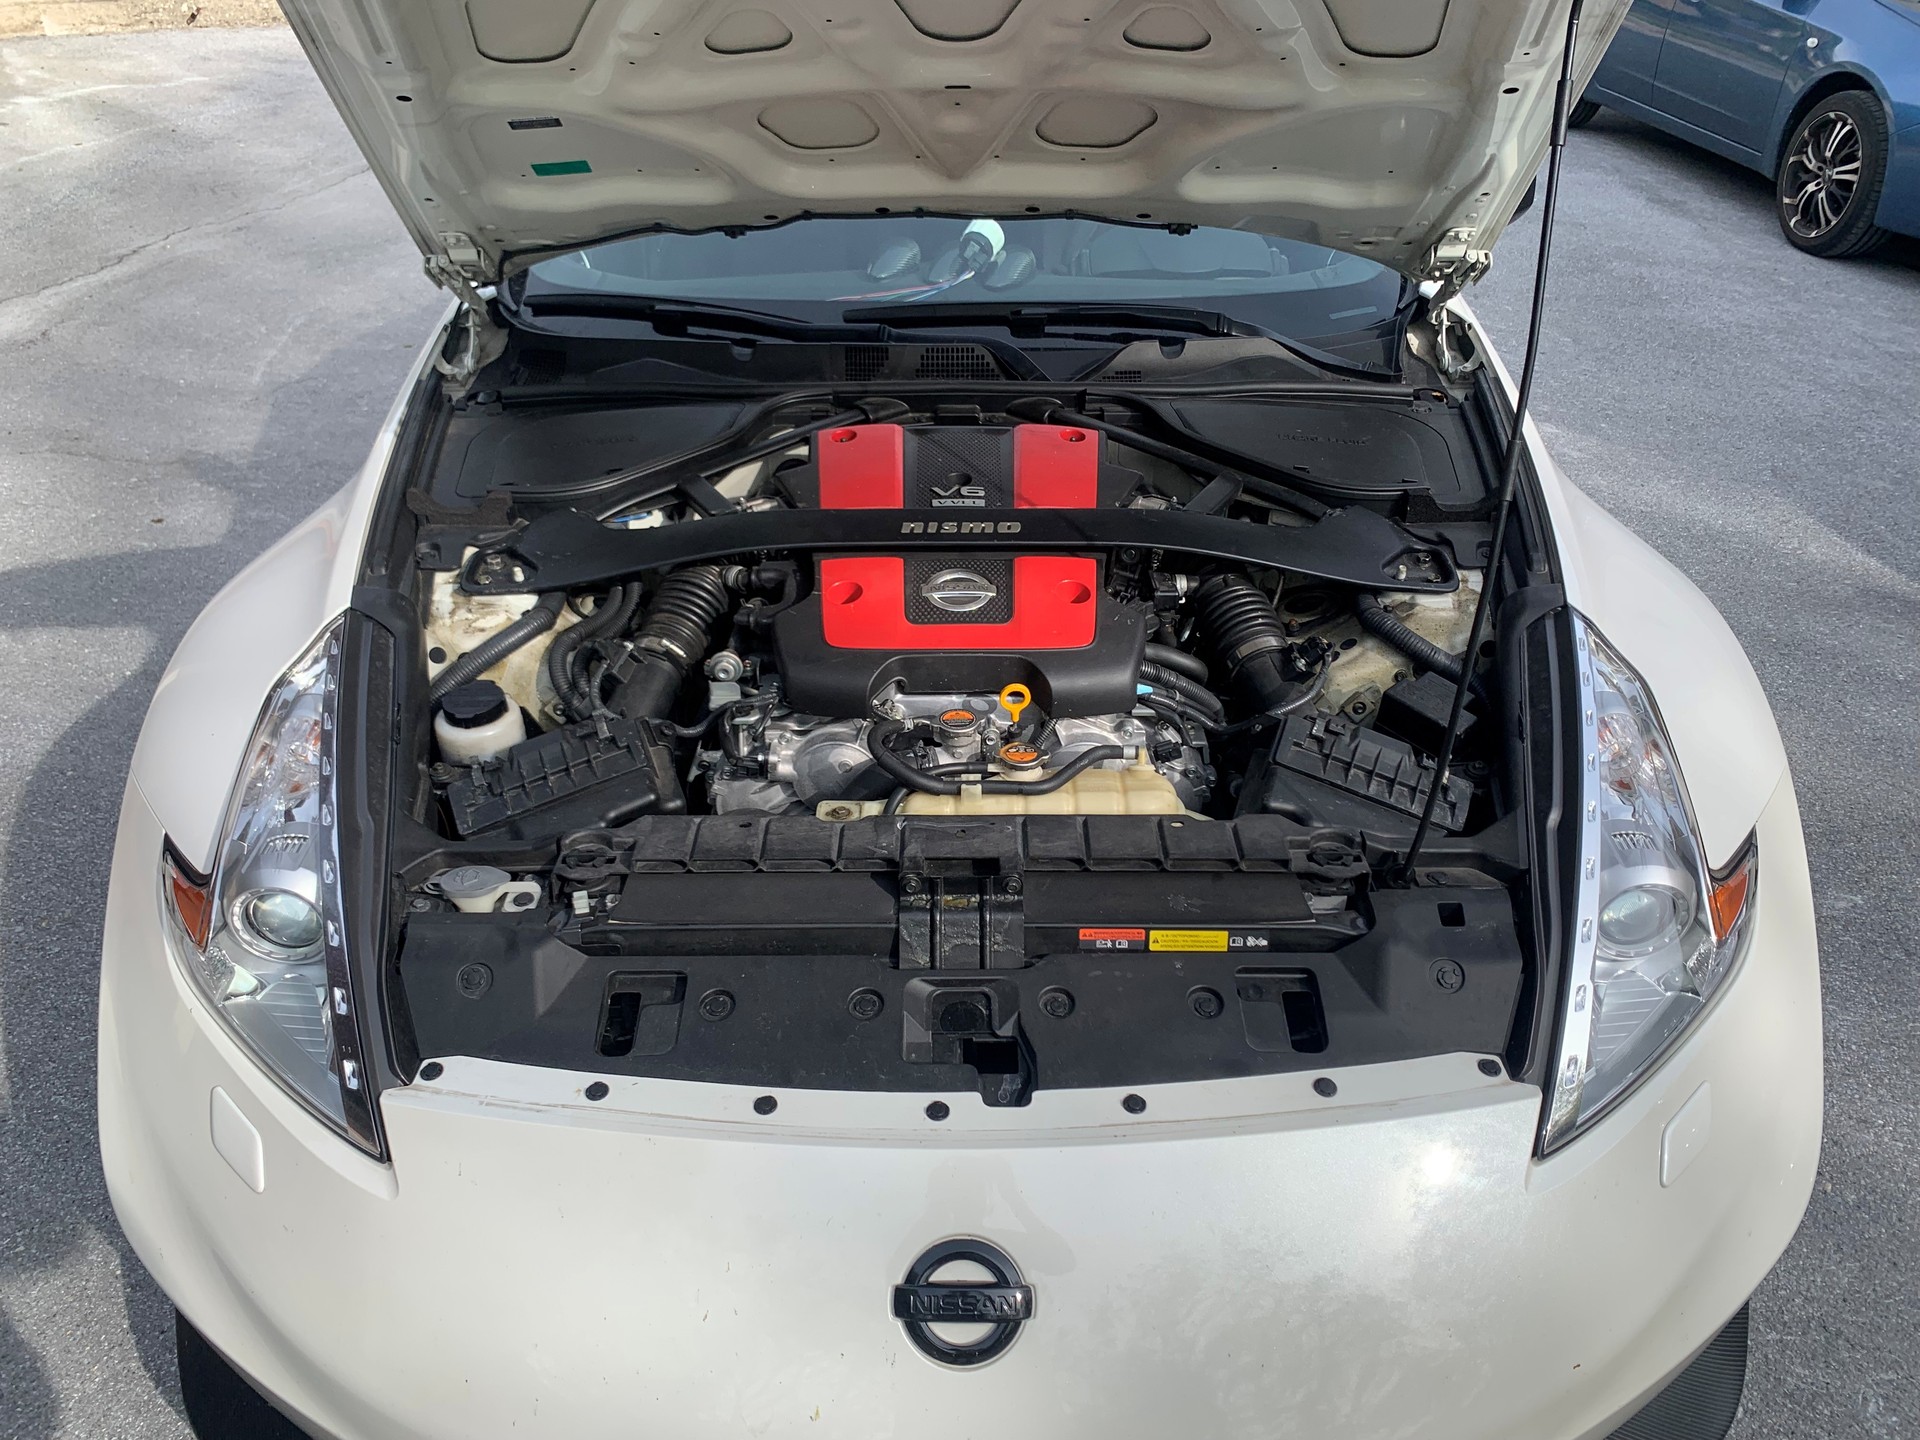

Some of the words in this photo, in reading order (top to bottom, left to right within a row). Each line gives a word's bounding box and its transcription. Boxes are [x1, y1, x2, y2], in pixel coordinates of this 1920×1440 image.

[931, 484, 986, 497] V6
[929, 583, 989, 592] NISSAN
[910, 1294, 1018, 1316] NISSAN
